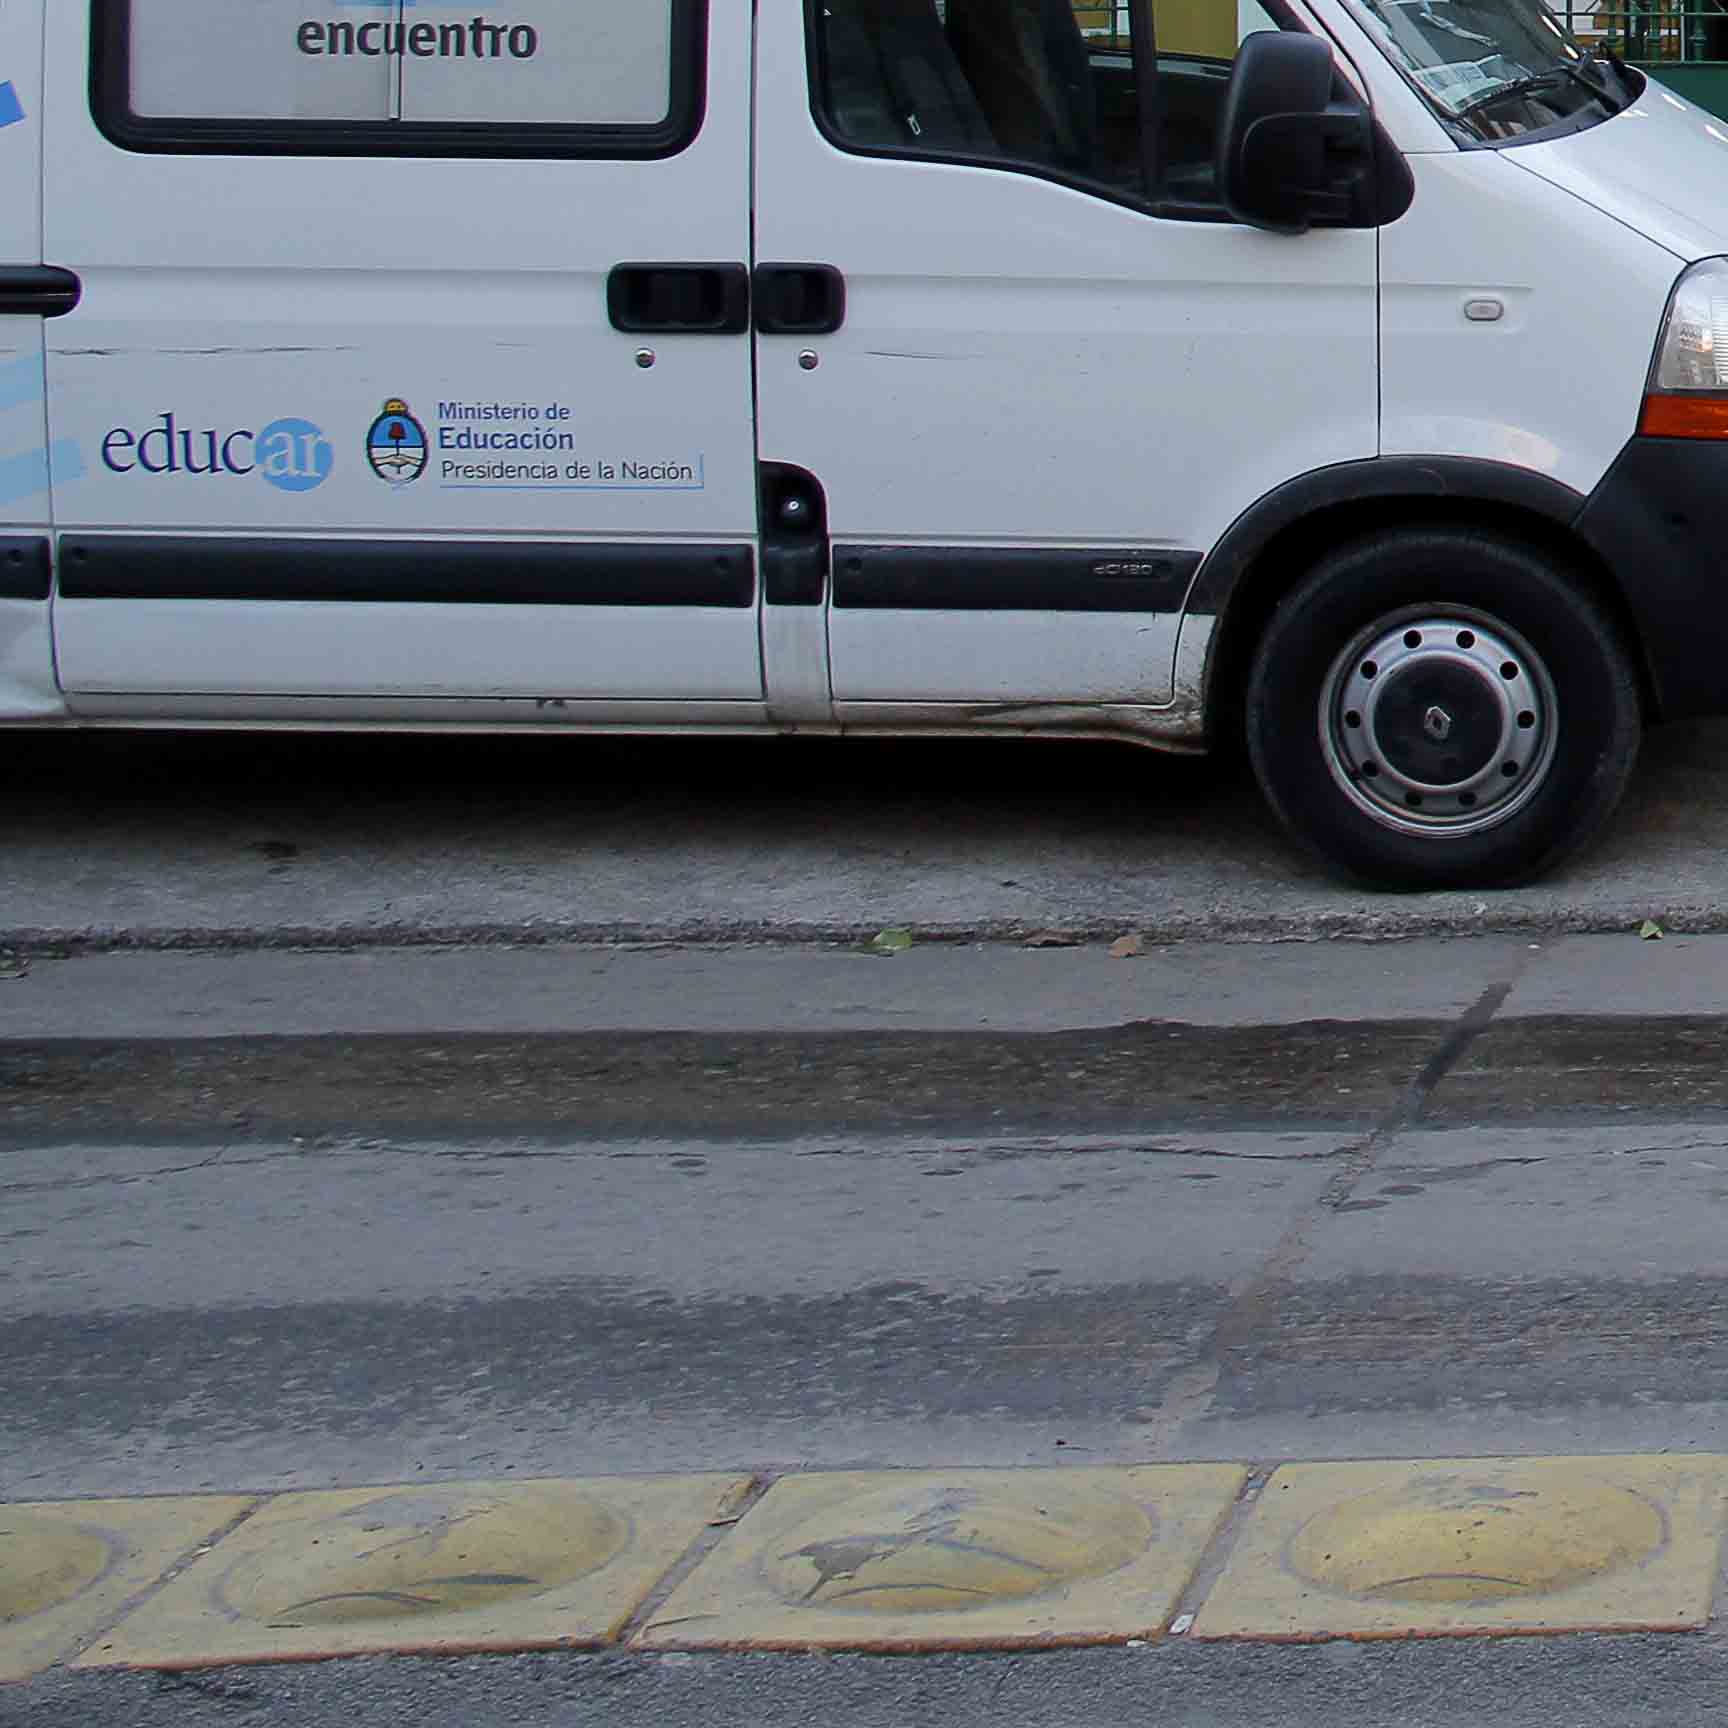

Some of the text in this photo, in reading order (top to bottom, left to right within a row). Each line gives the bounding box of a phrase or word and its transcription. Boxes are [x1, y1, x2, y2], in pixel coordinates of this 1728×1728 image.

[297, 16, 537, 59] encuentro
[438, 402, 571, 420] Ministerio de
[101, 412, 330, 476] educar
[438, 426, 575, 450] Educación
[441, 460, 693, 481] Presidencia de la Nación
